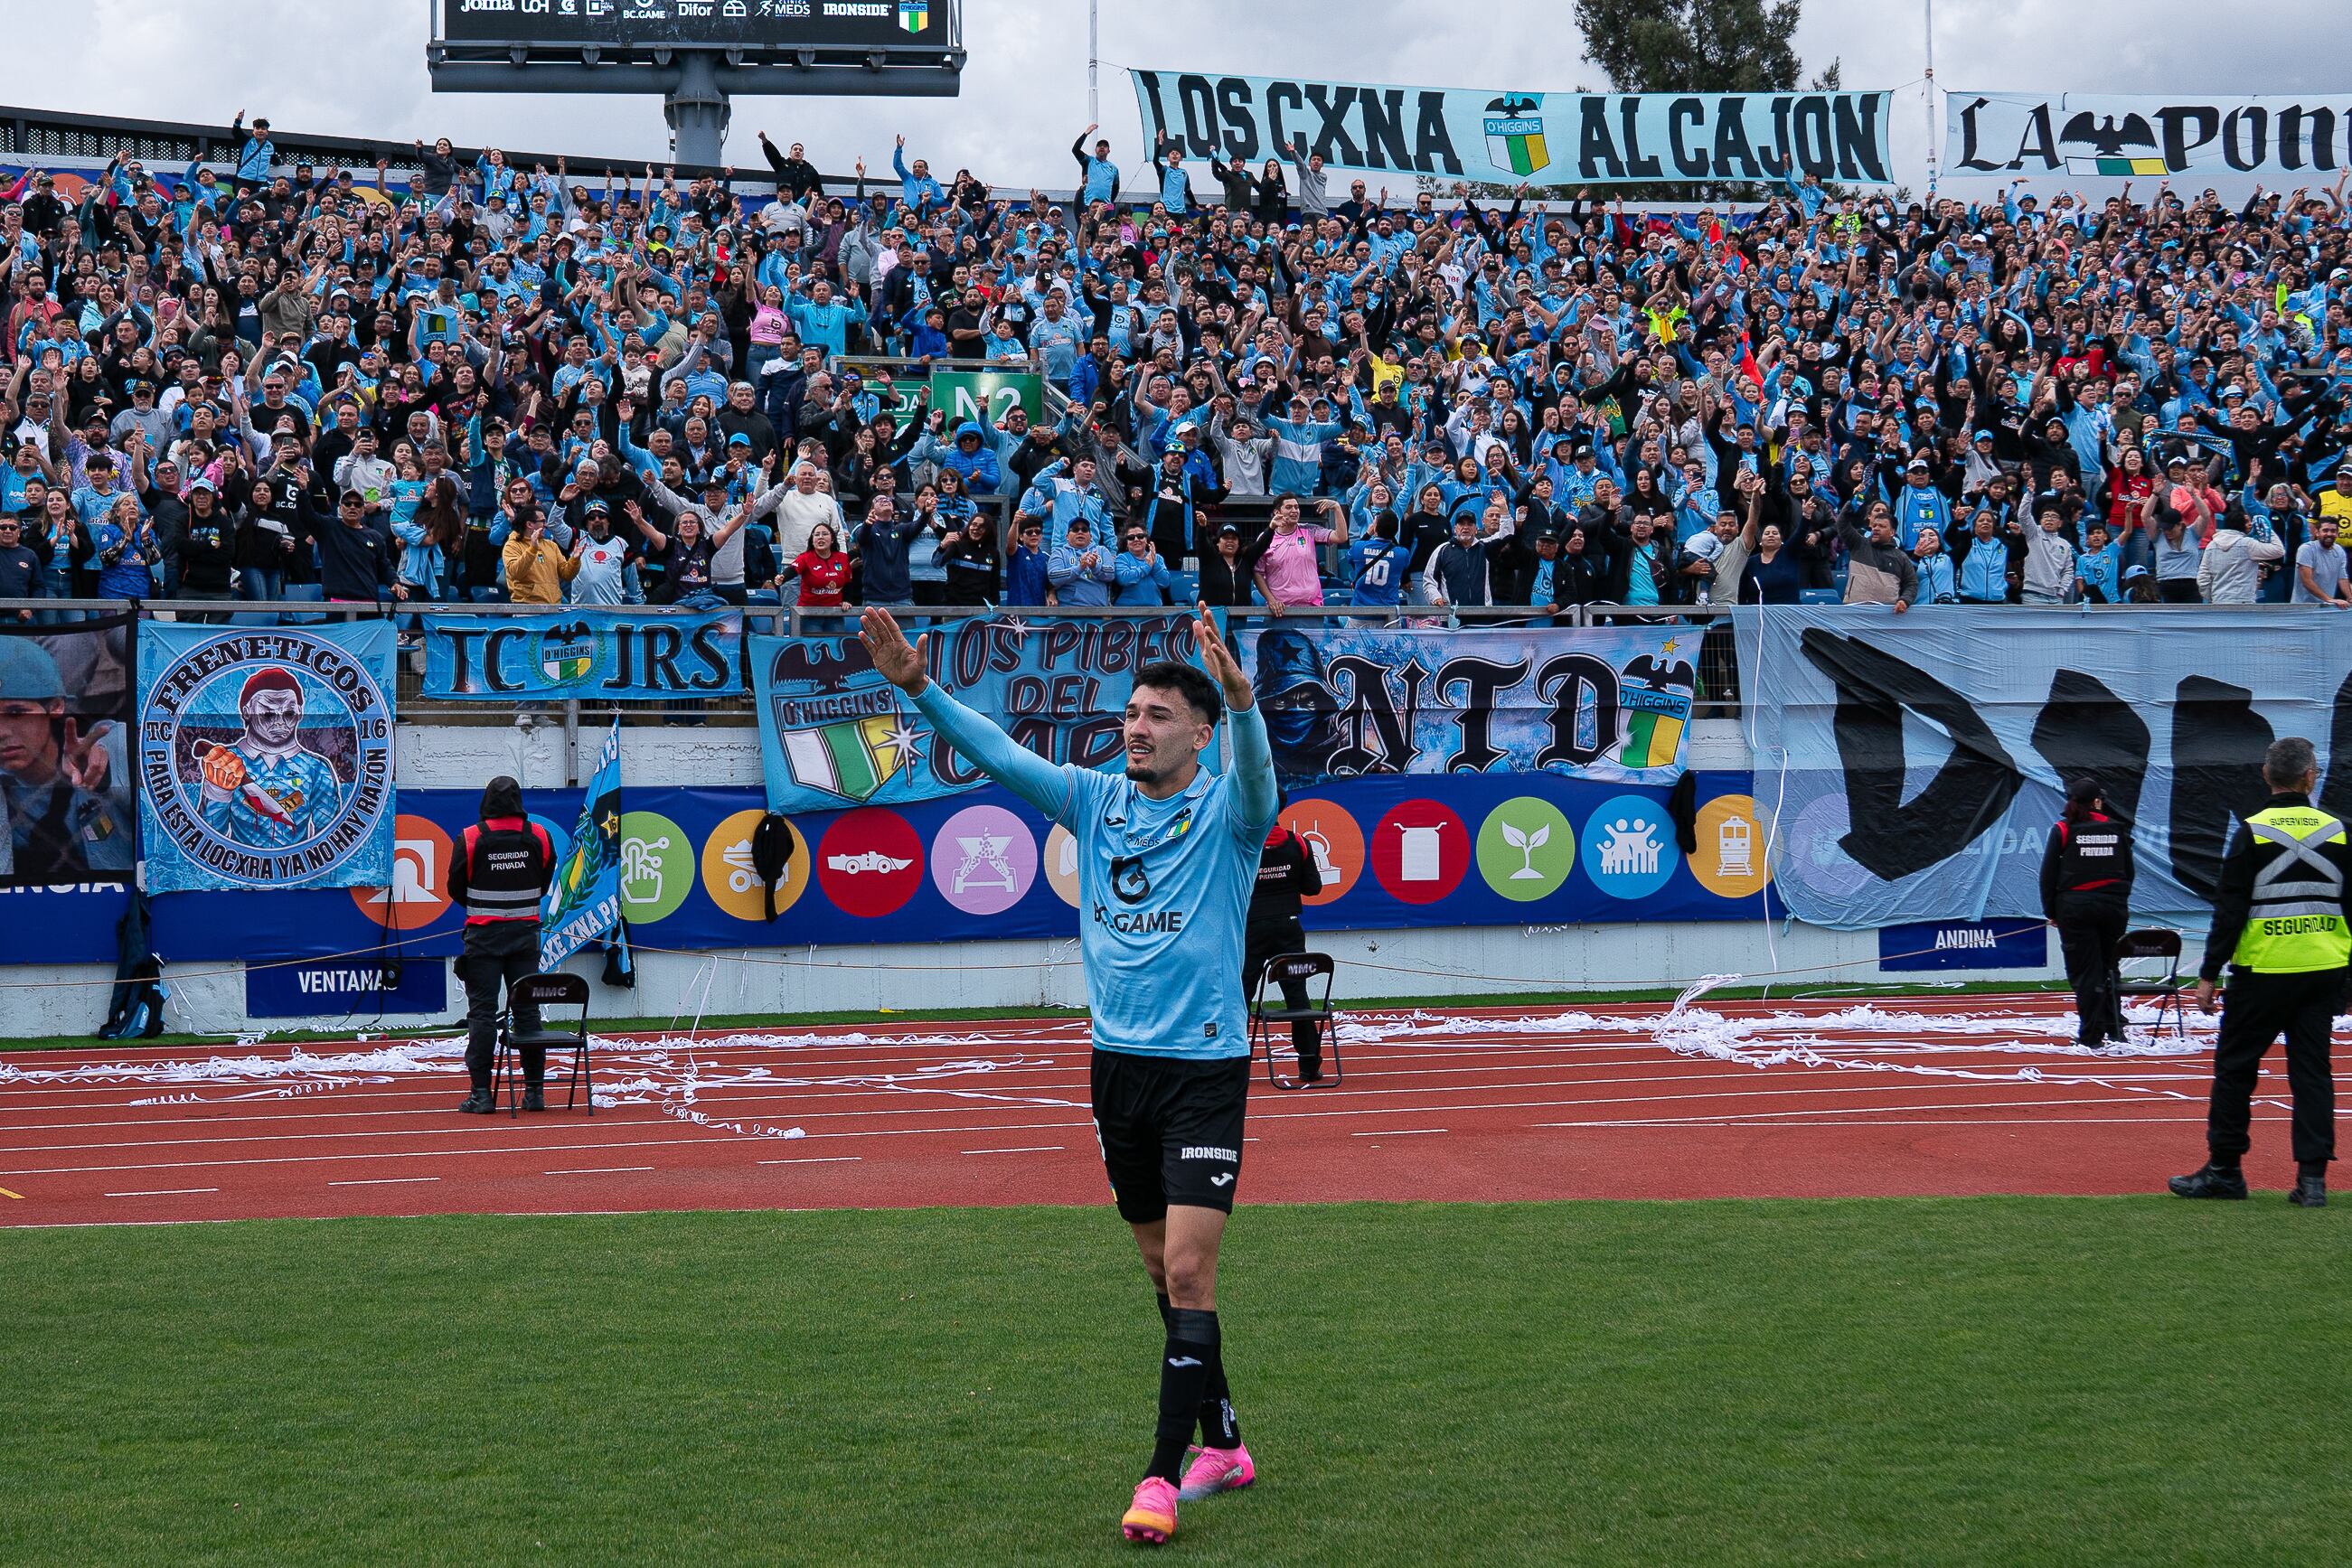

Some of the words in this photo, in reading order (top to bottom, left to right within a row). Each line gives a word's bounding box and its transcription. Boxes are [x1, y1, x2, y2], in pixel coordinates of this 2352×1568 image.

[623, 10, 666, 19] BC.GAME
[678, 3, 713, 16] Difor
[775, 5, 811, 15] MEDS
[823, 4, 889, 16] IRONSIDE
[1140, 71, 1259, 162] LOS
[1266, 81, 1464, 176] CXNA
[1486, 120, 1540, 133] O'HIGGINS
[1578, 96, 1664, 178] AL
[1669, 93, 1889, 181] CAJON
[1954, 97, 2066, 172] LA
[1366, 558, 1390, 587] 10
[544, 646, 590, 661] O'HIGGINS
[928, 613, 1029, 692] LOS
[153, 634, 376, 718] FRENETICOS
[1009, 675, 1107, 720] DEL
[1621, 690, 1688, 715] O'HIGGINS
[782, 688, 892, 726] O'HIGGINS
[145, 720, 174, 742] TC
[361, 718, 388, 741] 16
[146, 749, 177, 808] PARA
[163, 802, 205, 853] ESTA
[196, 838, 275, 880] LOCXRA
[275, 854, 307, 879] YA
[304, 840, 337, 871] NO
[326, 810, 369, 855] HAY
[353, 748, 387, 817] RAZÓN
[2270, 817, 2319, 827] SUPERVISOR
[1134, 837, 1161, 848] MEDS
[2075, 834, 2119, 845] SEGURIDAD
[488, 850, 529, 860] SEGURIDAD
[2080, 847, 2114, 857] PRIVADA
[491, 861, 526, 870] PRIVADA
[1257, 864, 1292, 874] EGURIDAD
[1258, 872, 1287, 880] PRIVADA
[561, 909, 605, 951] XNA
[2263, 916, 2337, 936] SEGURIDAD
[1934, 929, 1997, 950] ANDINA
[2133, 945, 2163, 955] MMC
[1287, 962, 1317, 975] MMC
[297, 969, 398, 993] VENTANA
[532, 986, 568, 999] MMC
[1181, 1146, 1237, 1163] IRONSIDE
